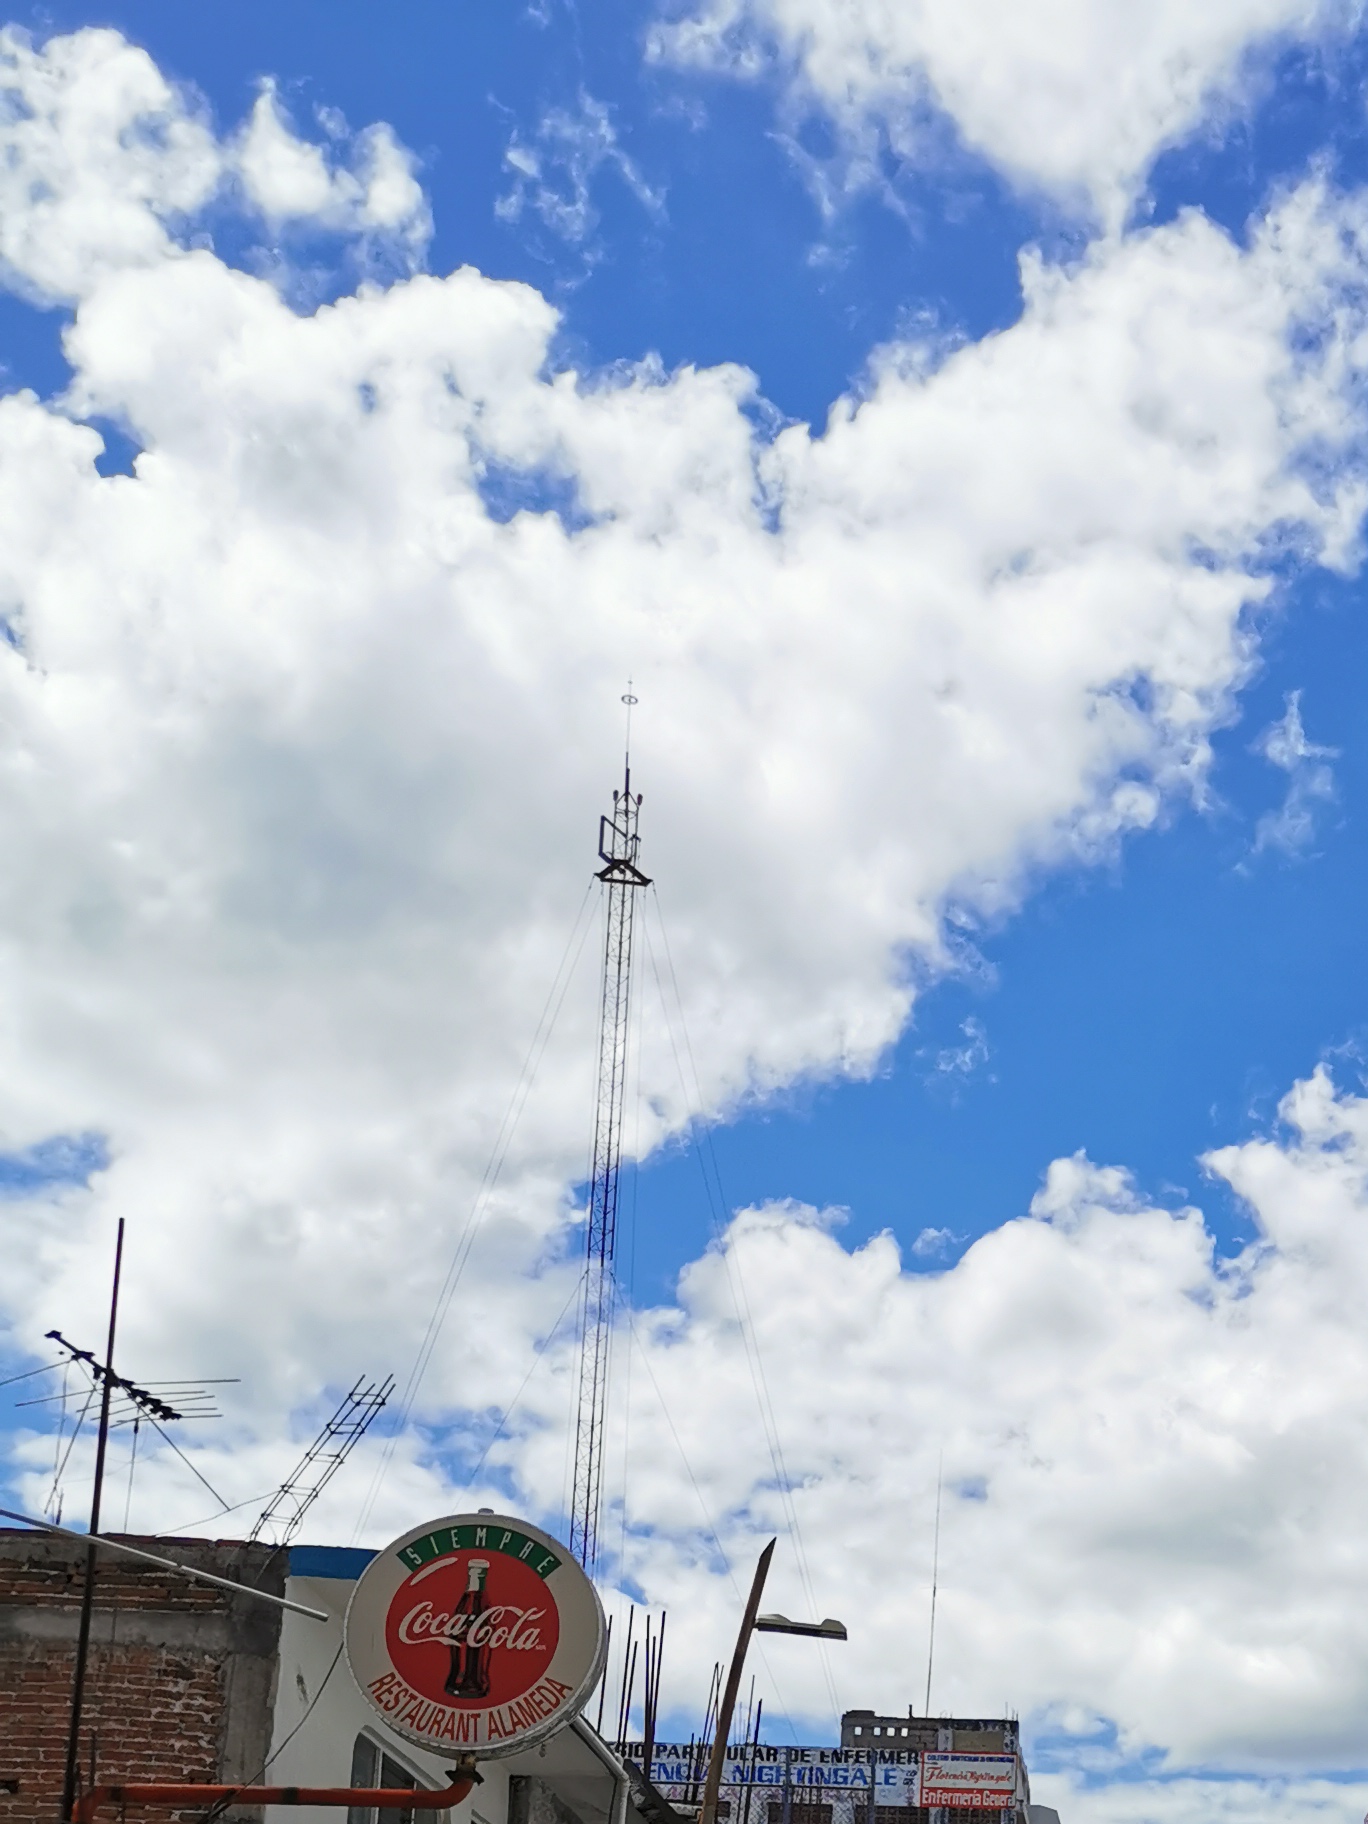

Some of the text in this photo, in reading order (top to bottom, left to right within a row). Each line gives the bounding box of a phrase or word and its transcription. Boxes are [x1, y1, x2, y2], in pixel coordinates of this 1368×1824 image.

[406, 1527, 556, 1574] SIEMPRE
[398, 1600, 547, 1651] Coca-Cola
[367, 1671, 573, 1743] RESTAURANT ALAMEDA
[790, 1748, 811, 1762] DE
